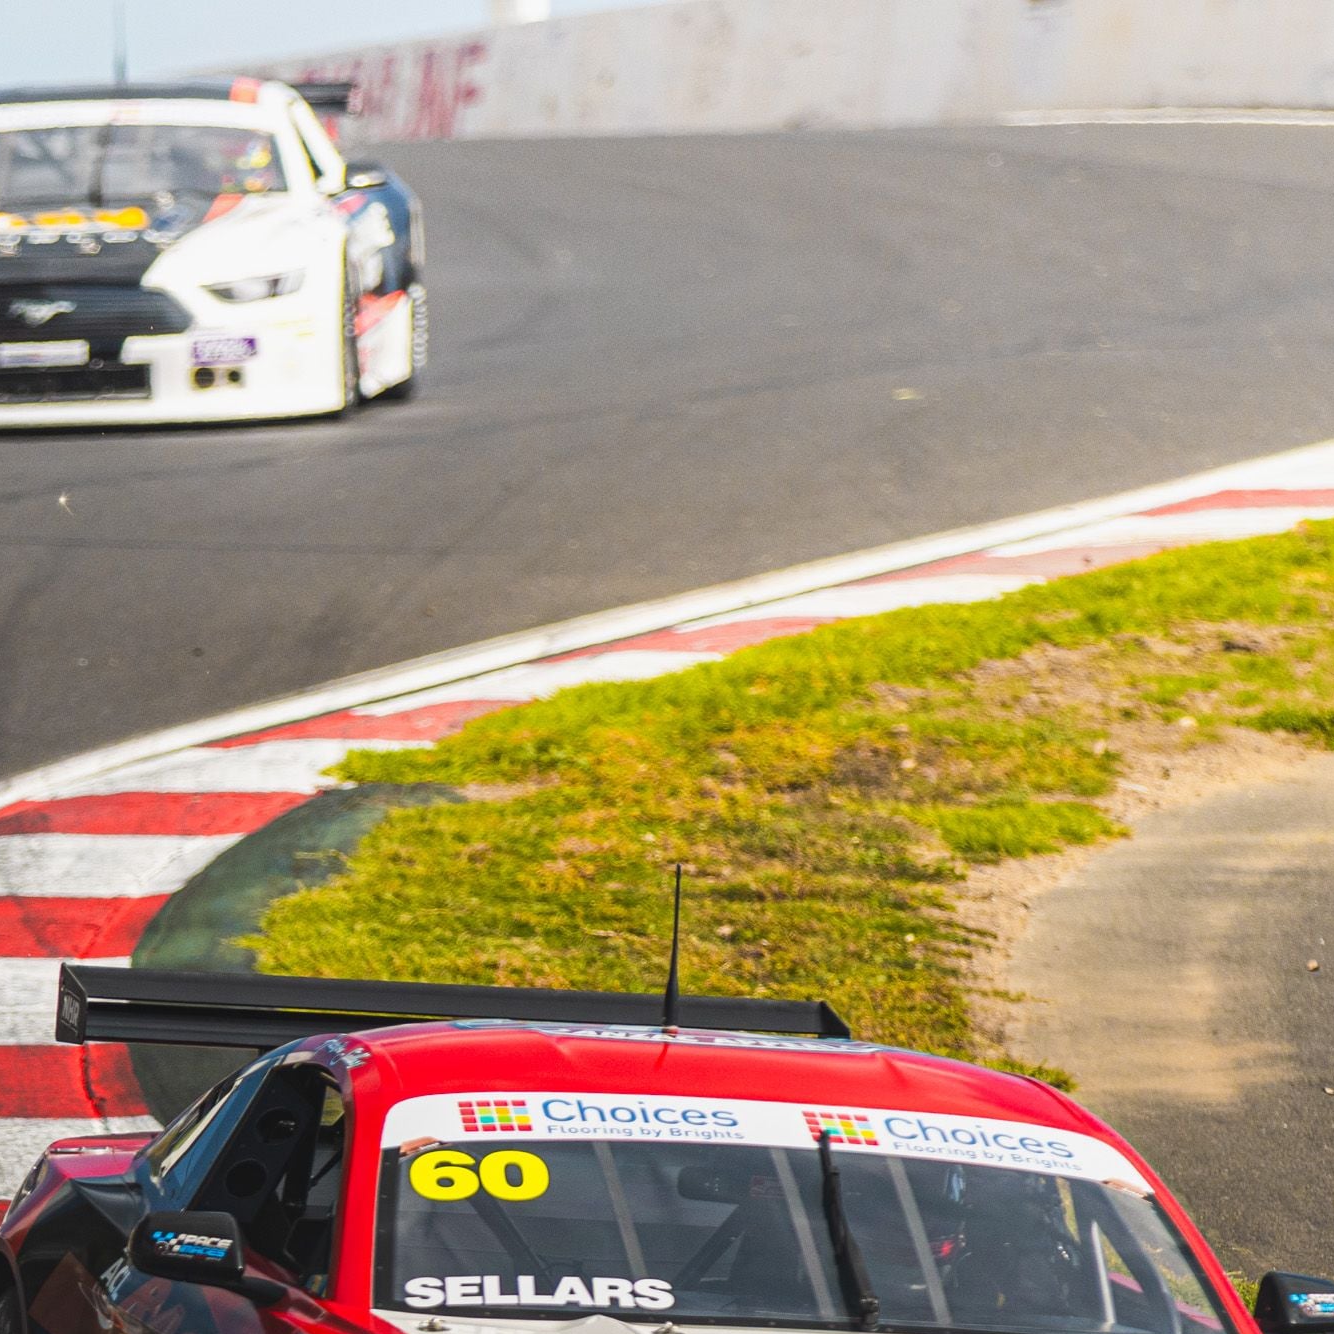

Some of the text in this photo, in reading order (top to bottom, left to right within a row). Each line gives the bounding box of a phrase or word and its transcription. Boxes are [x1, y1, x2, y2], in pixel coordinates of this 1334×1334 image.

[542, 1099, 740, 1128] Choices
[548, 1124, 746, 1141] Flooring by Brights
[884, 1117, 1075, 1160] Choices
[893, 1143, 1083, 1171] Flooring by Brights
[409, 1150, 550, 1201] 60
[404, 1275, 675, 1310] SELLARS
